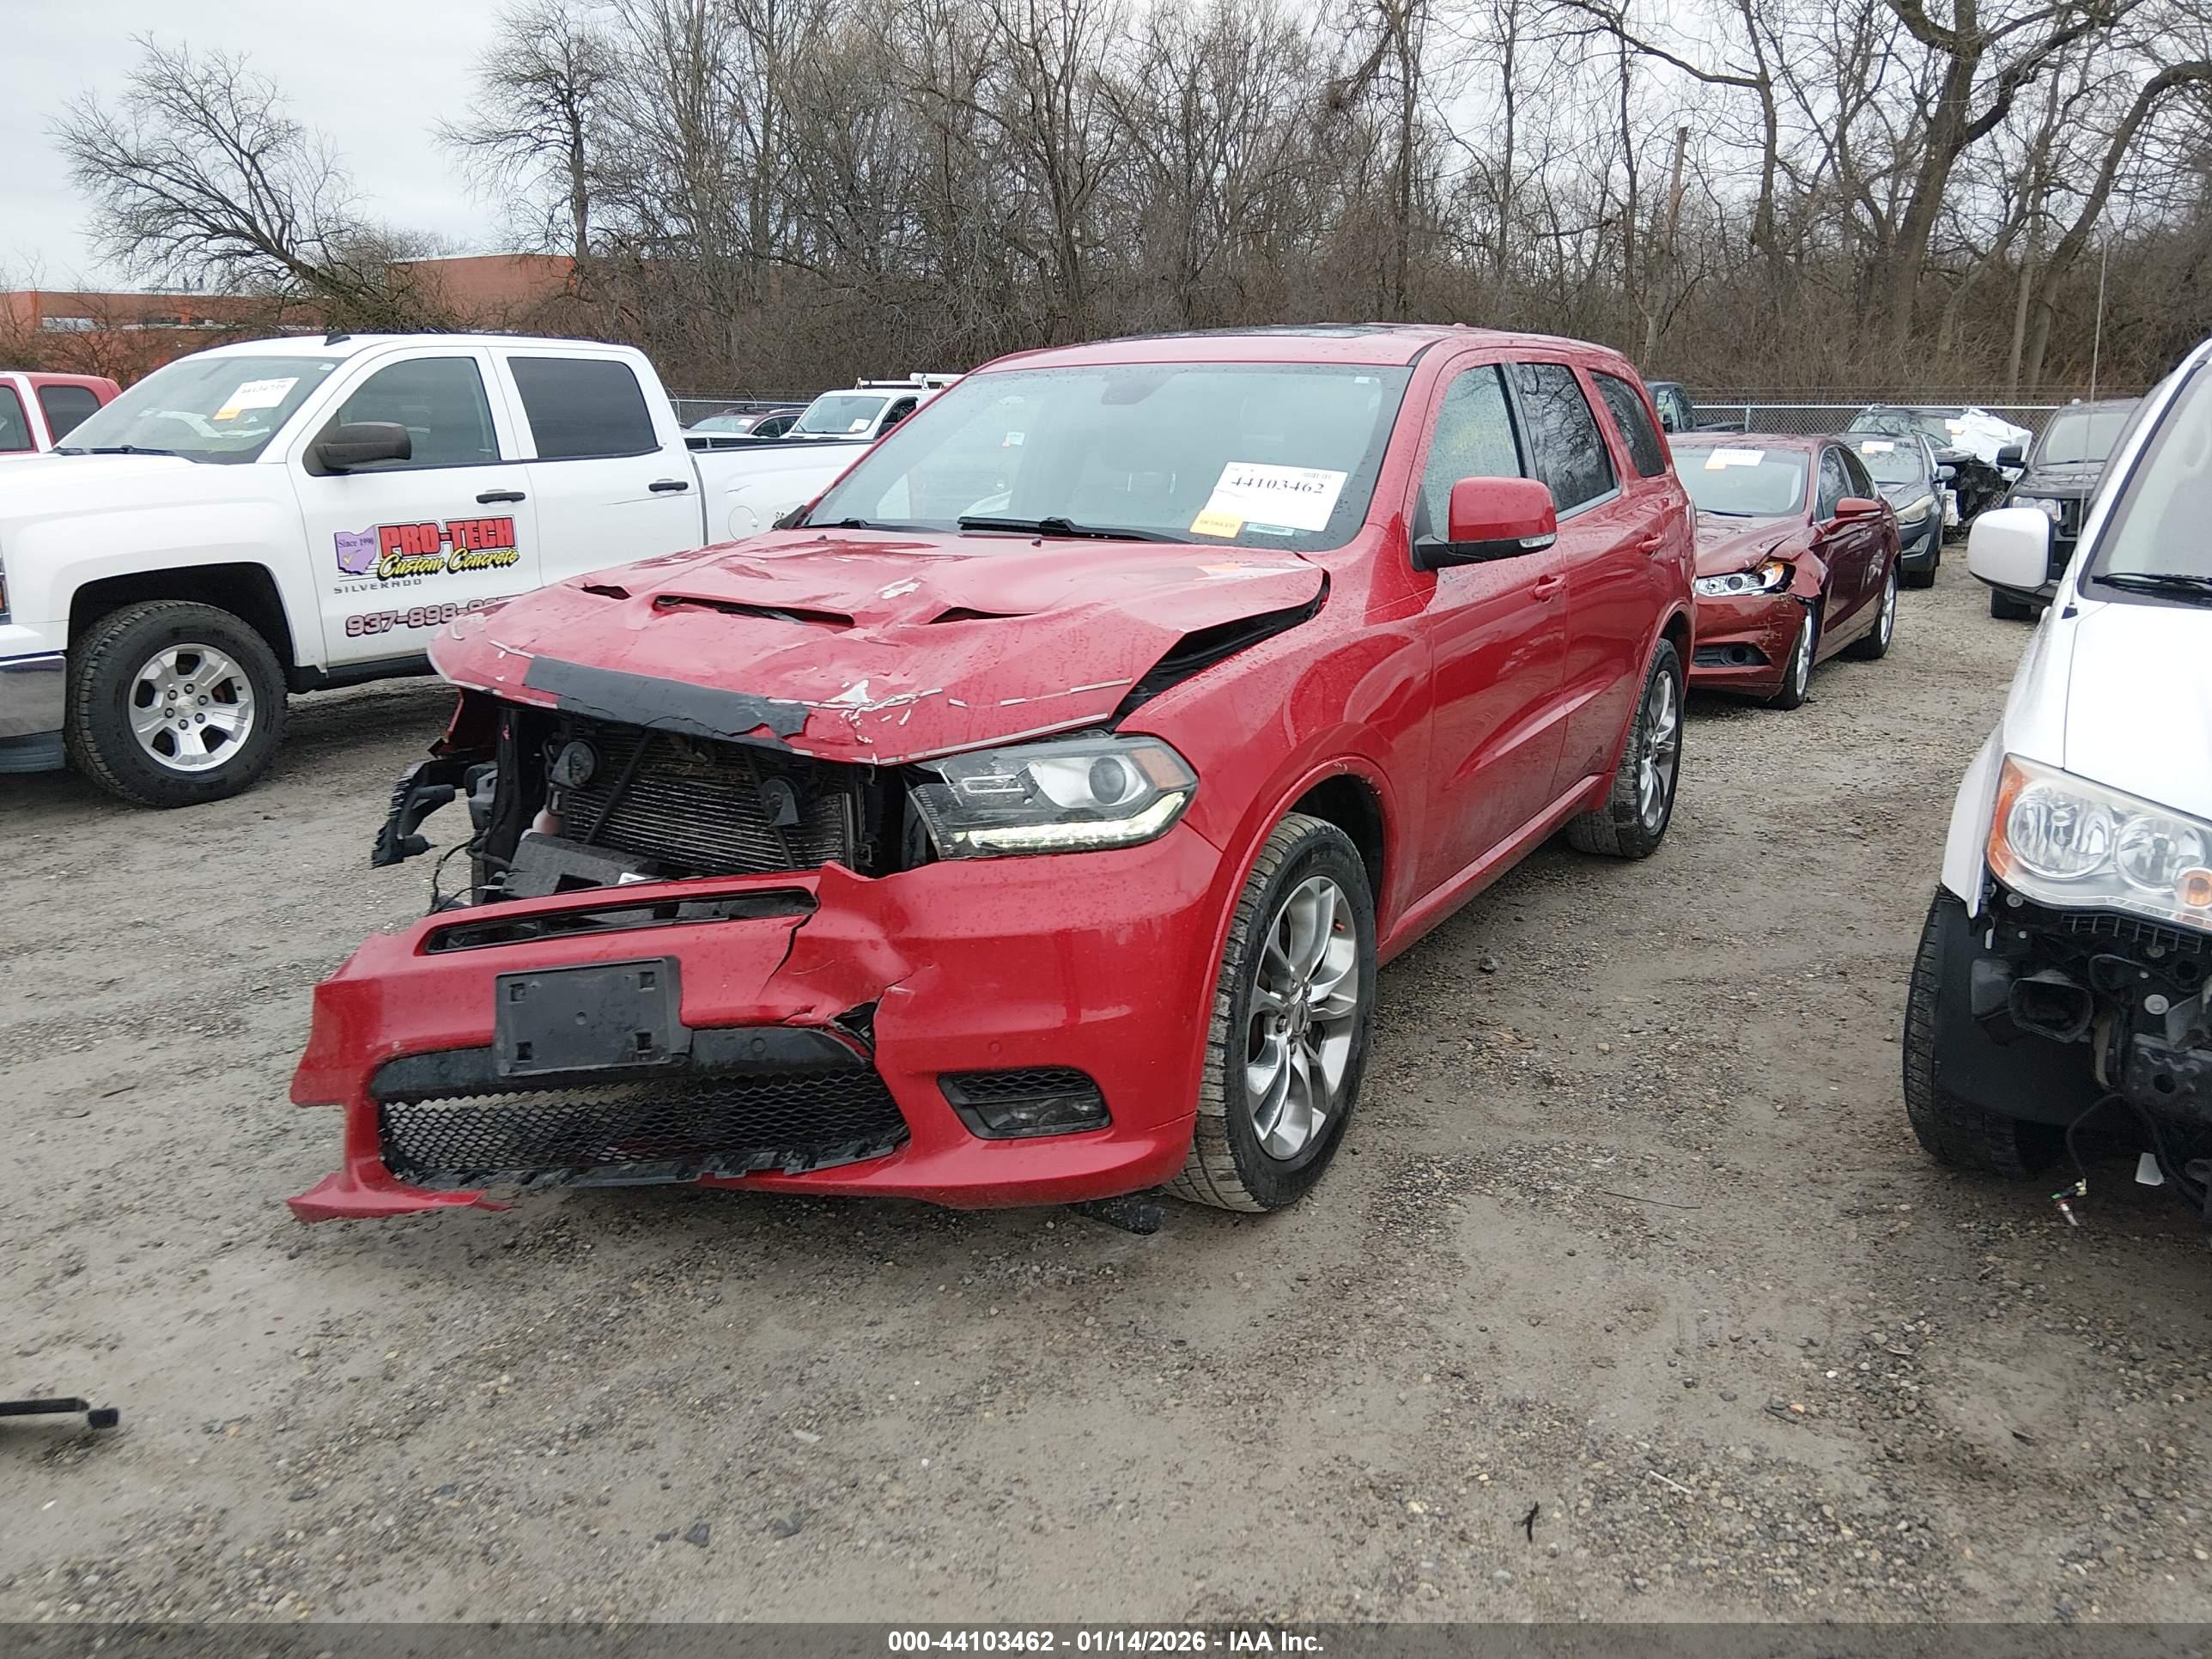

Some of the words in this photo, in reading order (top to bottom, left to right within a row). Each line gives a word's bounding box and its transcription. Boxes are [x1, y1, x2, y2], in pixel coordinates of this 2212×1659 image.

[1231, 477, 1325, 494] 44103462
[338, 539, 358, 548] Since
[378, 517, 515, 556] PRO-TECH
[378, 553, 446, 580] Custom
[447, 548, 520, 574] Concrete
[334, 578, 422, 594] SILVERADO
